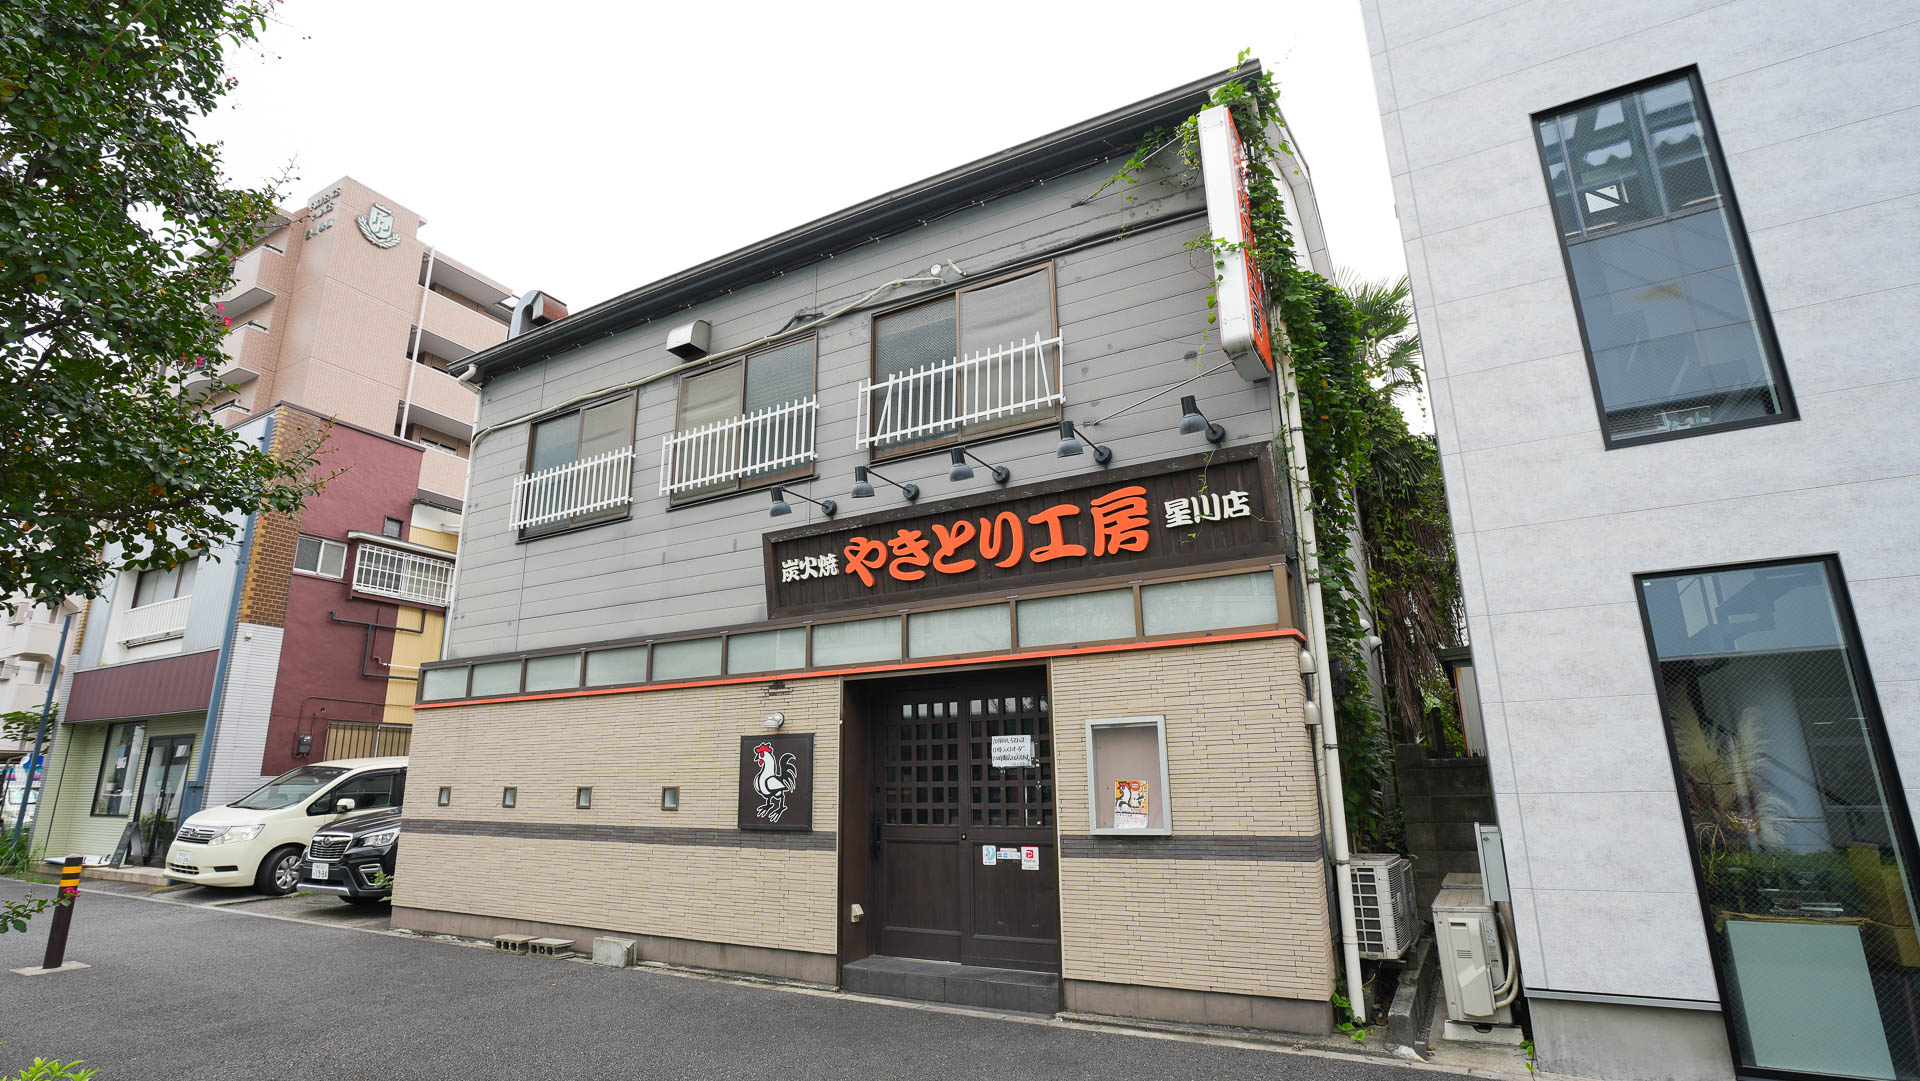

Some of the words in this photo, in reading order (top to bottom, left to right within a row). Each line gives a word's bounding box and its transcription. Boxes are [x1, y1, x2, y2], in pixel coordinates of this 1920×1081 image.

[781, 553, 840, 583] 炭火焼
[843, 485, 1151, 588] やきとり工房
[1163, 490, 1251, 529] 星川店
